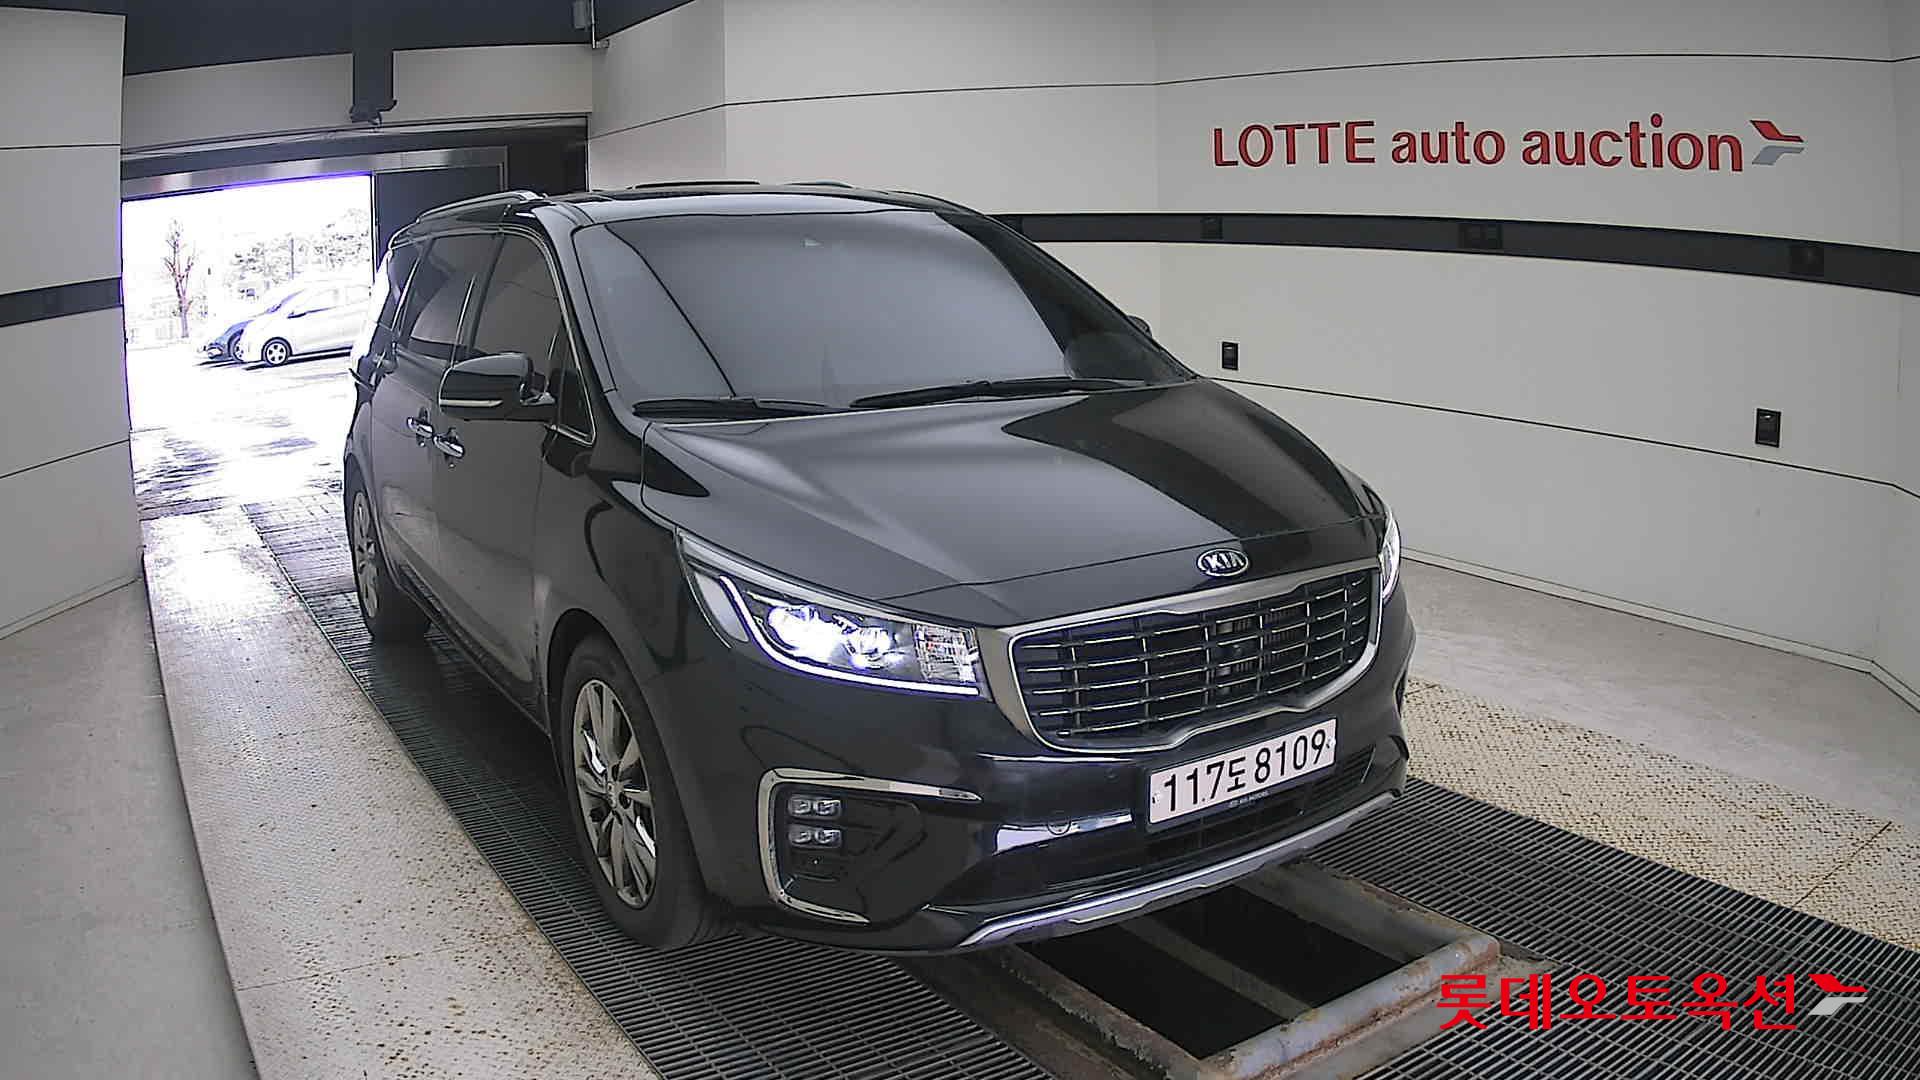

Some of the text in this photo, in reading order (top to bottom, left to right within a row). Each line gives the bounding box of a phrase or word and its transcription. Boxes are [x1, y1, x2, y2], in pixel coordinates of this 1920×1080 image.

[1212, 113, 1743, 172] LOTTE auto auction
[1203, 552, 1245, 569] KIA
